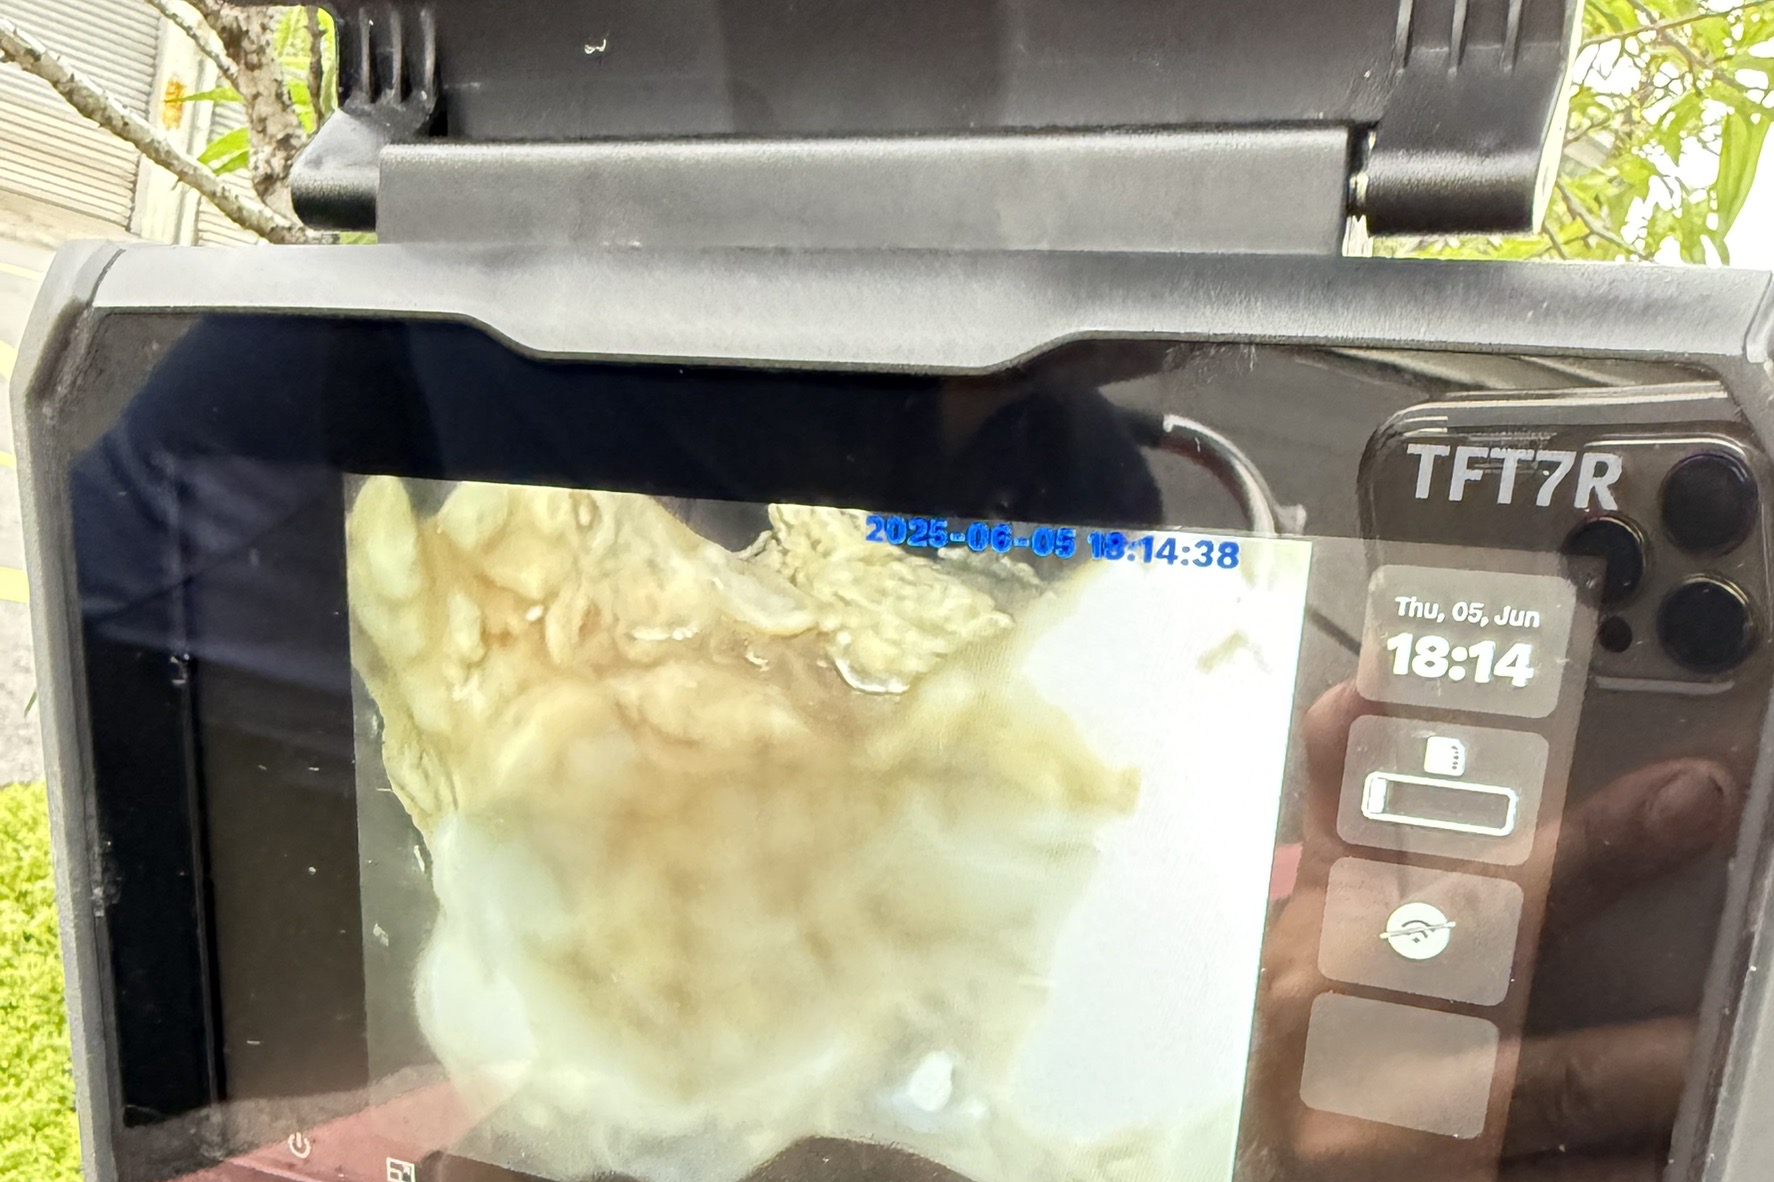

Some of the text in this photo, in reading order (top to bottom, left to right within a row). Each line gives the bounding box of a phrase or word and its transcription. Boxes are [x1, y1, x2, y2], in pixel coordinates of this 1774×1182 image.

[1407, 443, 1623, 511] TFT7R
[866, 514, 1240, 570] 2025-06-05 18:14:38
[1395, 596, 1541, 628] Thu, 05, Jun
[1386, 632, 1536, 687] 18:14
